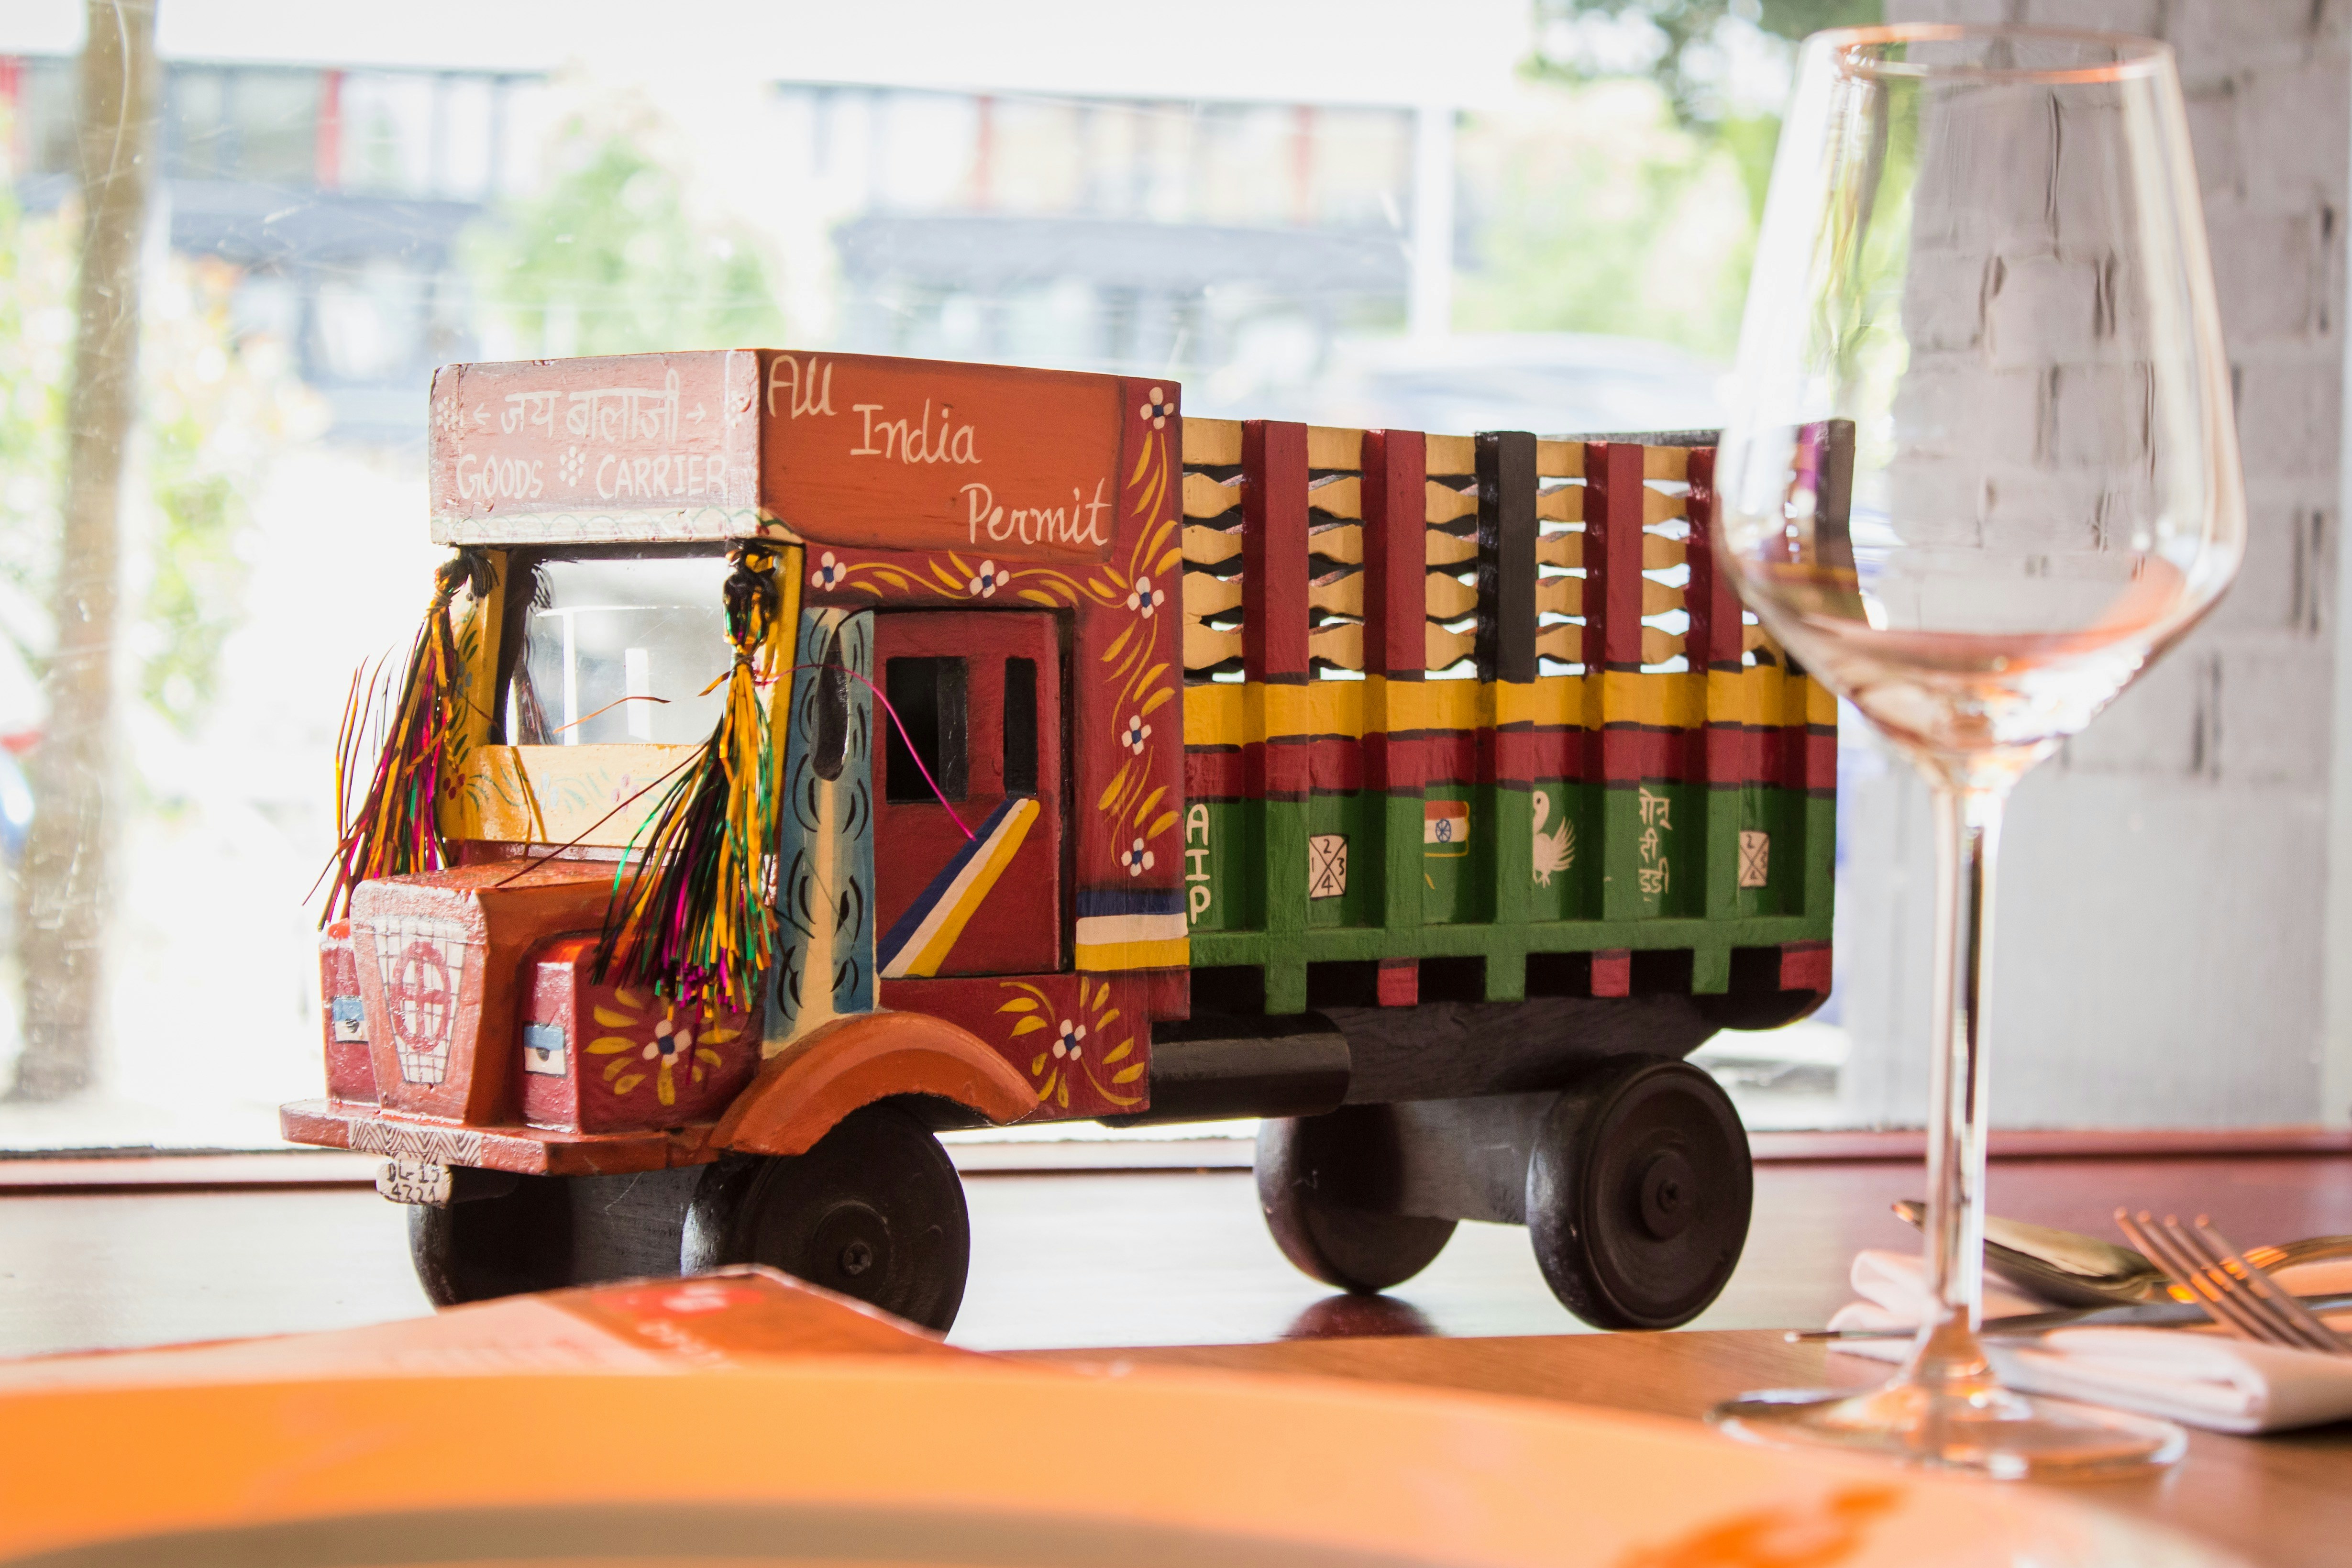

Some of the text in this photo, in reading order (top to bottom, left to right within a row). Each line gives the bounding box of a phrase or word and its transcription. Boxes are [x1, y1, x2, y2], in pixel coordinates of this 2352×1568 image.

[500, 367, 680, 444] जय बालाजी
[767, 354, 838, 419] All
[850, 398, 982, 464] India
[456, 453, 729, 500] GOODS CARRIER
[960, 477, 1112, 546] Permit
[1323, 839, 1332, 854] 2
[1336, 857, 1345, 876] 3
[1321, 874, 1334, 895] 4
